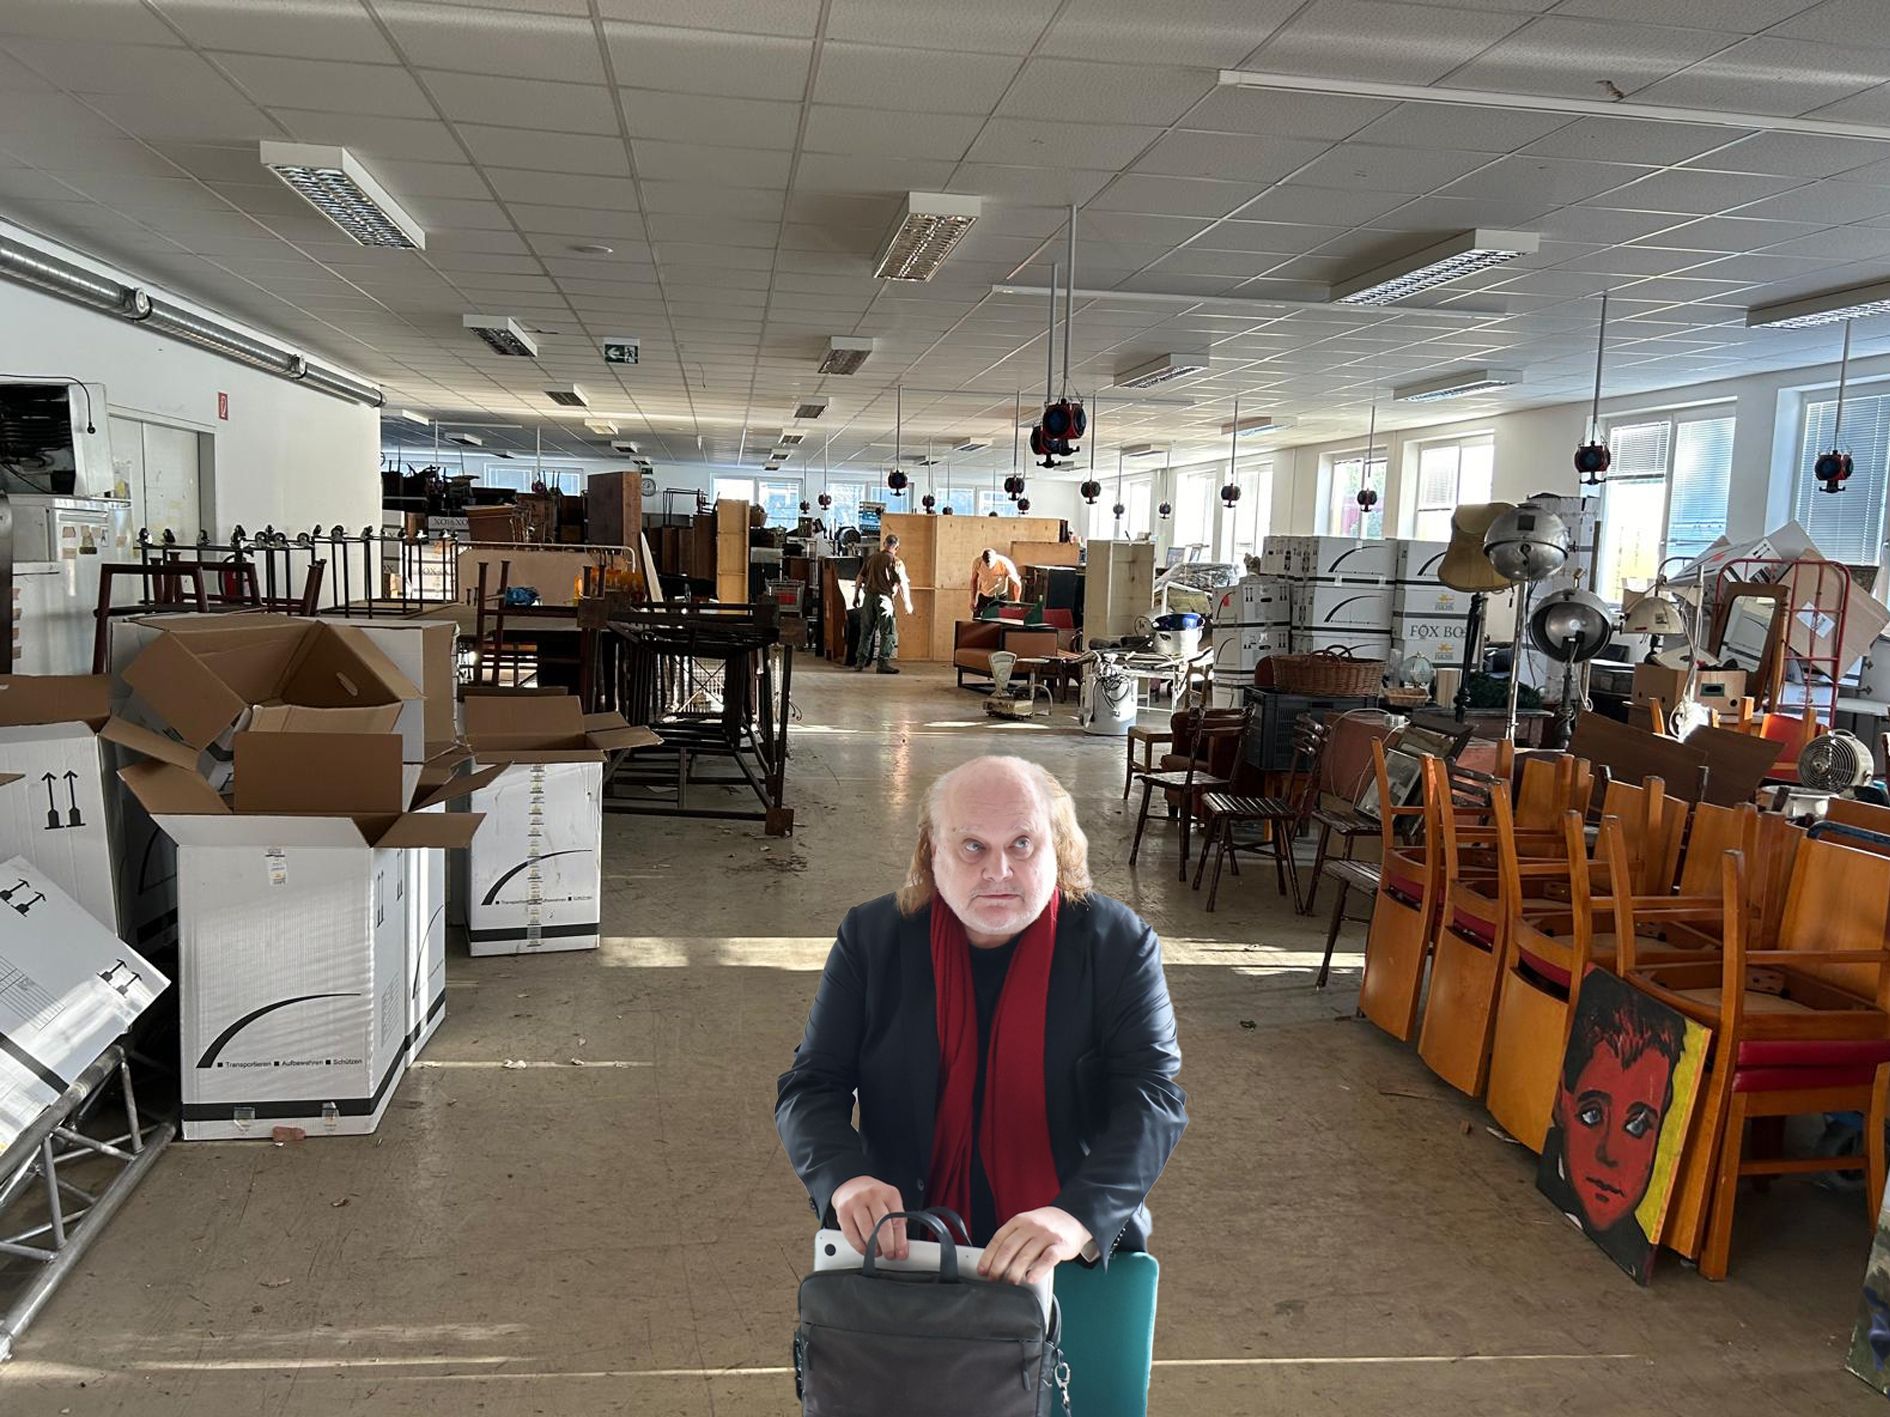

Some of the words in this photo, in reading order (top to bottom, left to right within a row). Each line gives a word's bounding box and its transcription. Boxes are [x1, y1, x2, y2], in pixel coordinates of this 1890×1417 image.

[1410, 624, 1439, 639] FOX
[1444, 625, 1466, 638] BO
[282, 1059, 323, 1067] Aufbewahren
[333, 1058, 363, 1066] Schützen
